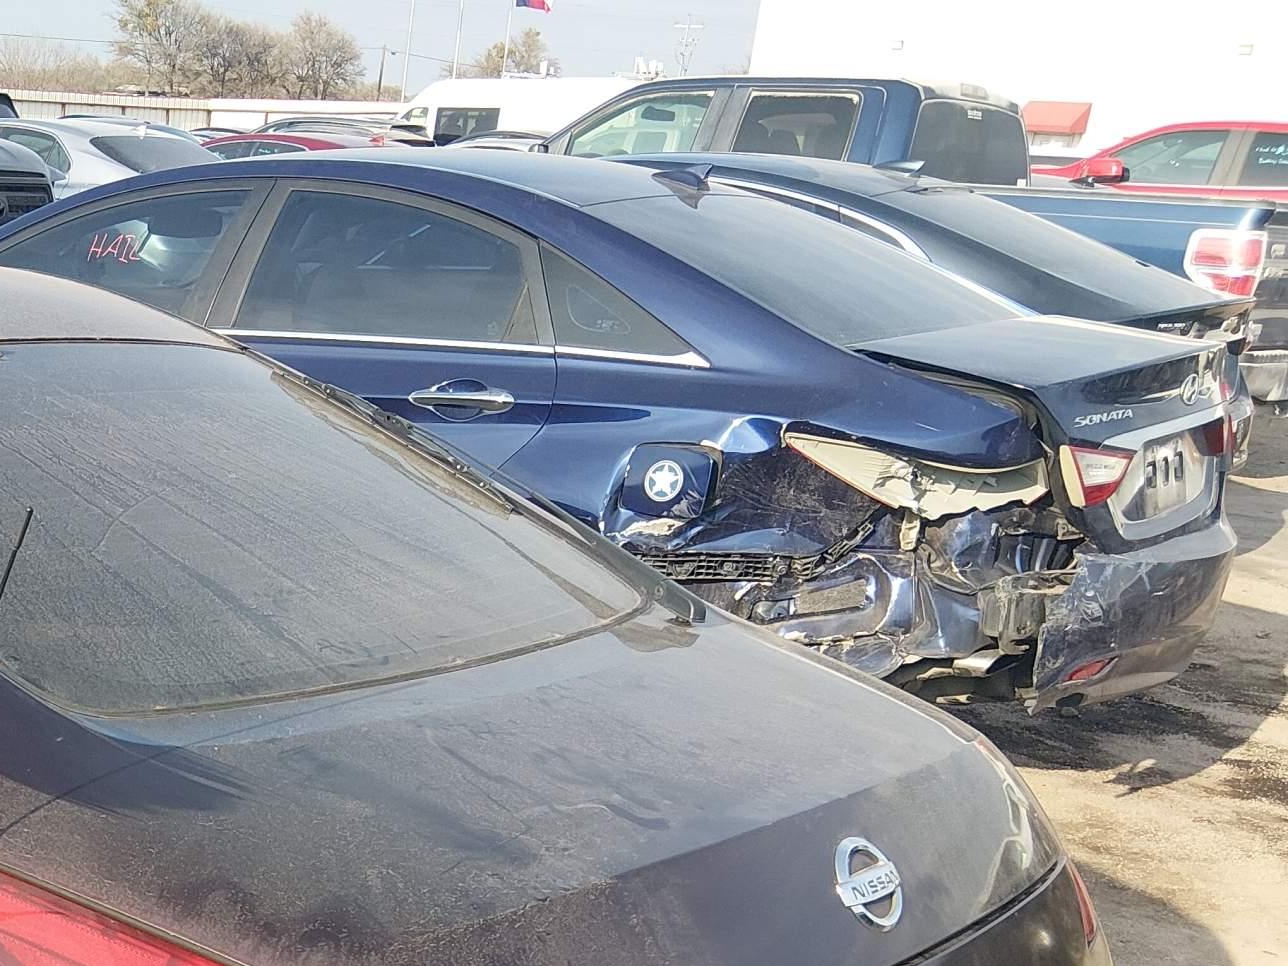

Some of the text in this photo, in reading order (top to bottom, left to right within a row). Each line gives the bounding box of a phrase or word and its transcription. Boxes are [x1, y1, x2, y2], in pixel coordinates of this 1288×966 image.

[87, 233, 141, 264] HAIL
[1073, 408, 1134, 428] SONATA
[850, 870, 899, 901] NISSAN
